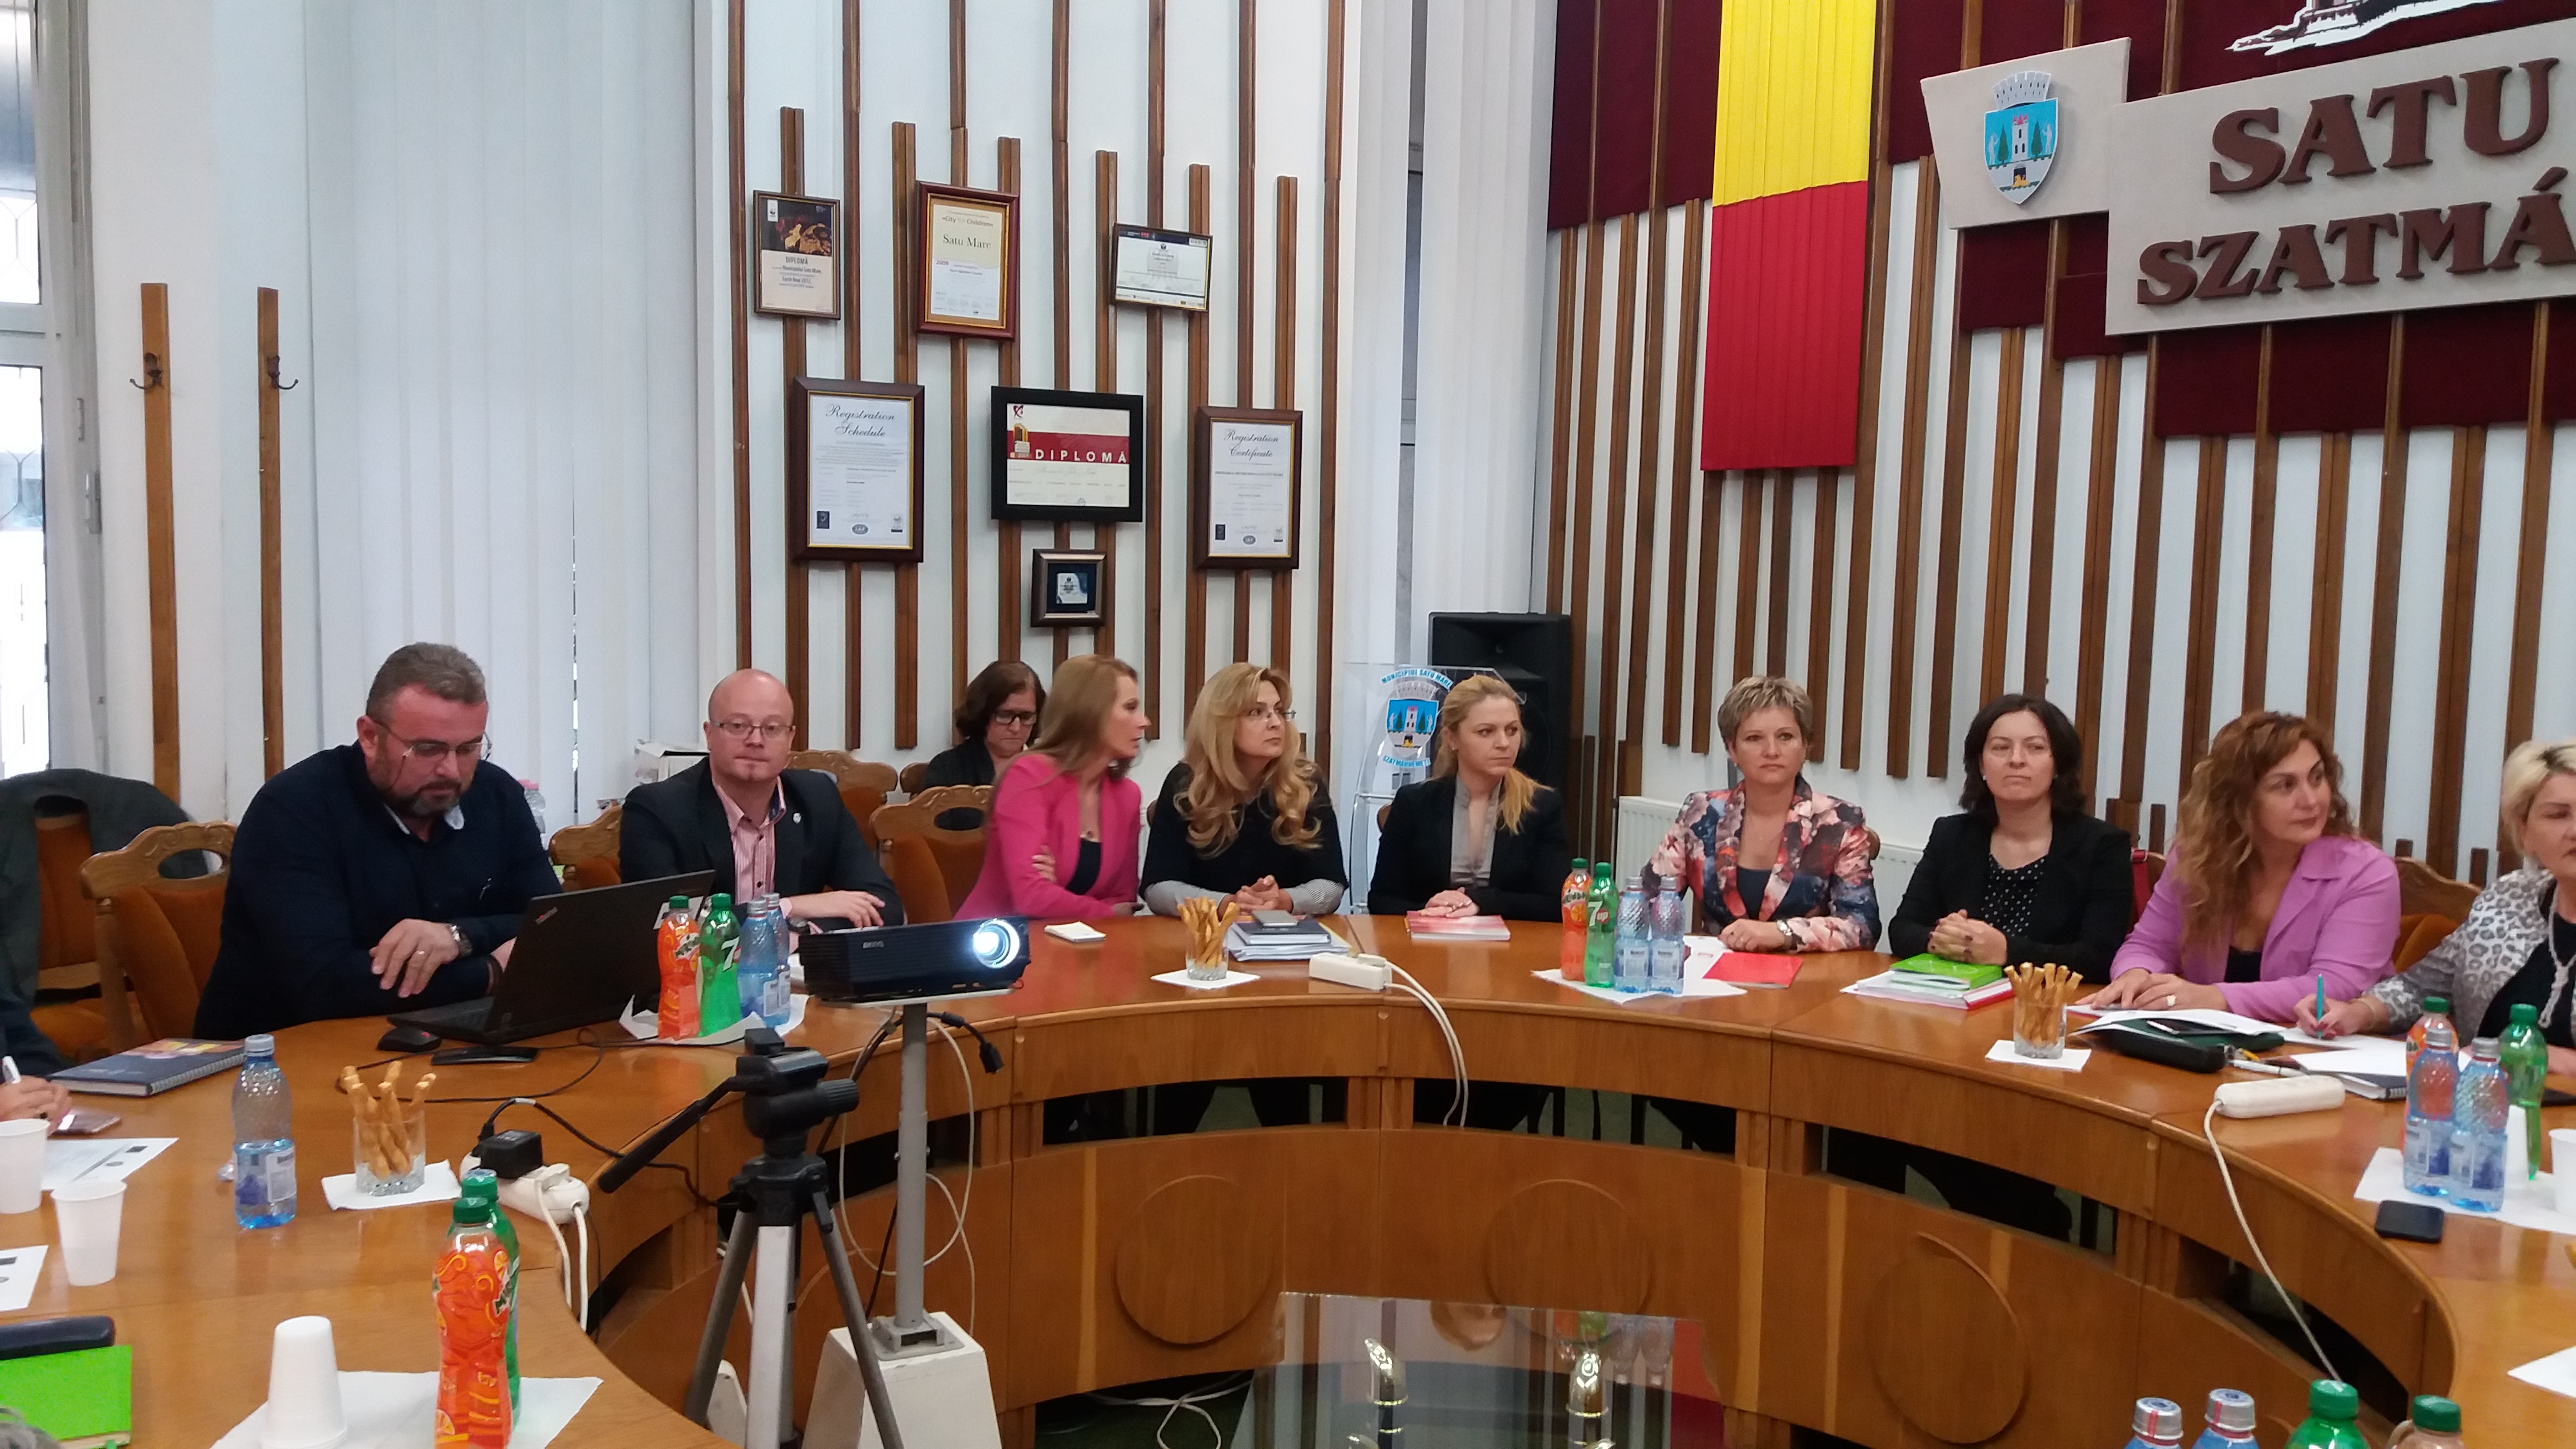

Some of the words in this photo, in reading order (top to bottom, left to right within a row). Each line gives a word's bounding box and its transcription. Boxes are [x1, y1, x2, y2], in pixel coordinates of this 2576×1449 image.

[2209, 57, 2560, 195] SATU
[942, 233, 964, 245] Satu
[966, 237, 991, 249] Mare
[2137, 166, 2576, 306] SZATMÁ
[826, 403, 895, 423] Registration
[835, 422, 886, 437] Schedule
[1223, 428, 1279, 444] Registration
[1229, 443, 1273, 460] Certificate
[1381, 669, 1417, 684] MUNICIPIUL
[1420, 669, 1435, 678] SATU
[1588, 900, 1603, 928] 7
[1596, 912, 1609, 922] up
[721, 935, 740, 972] 7
